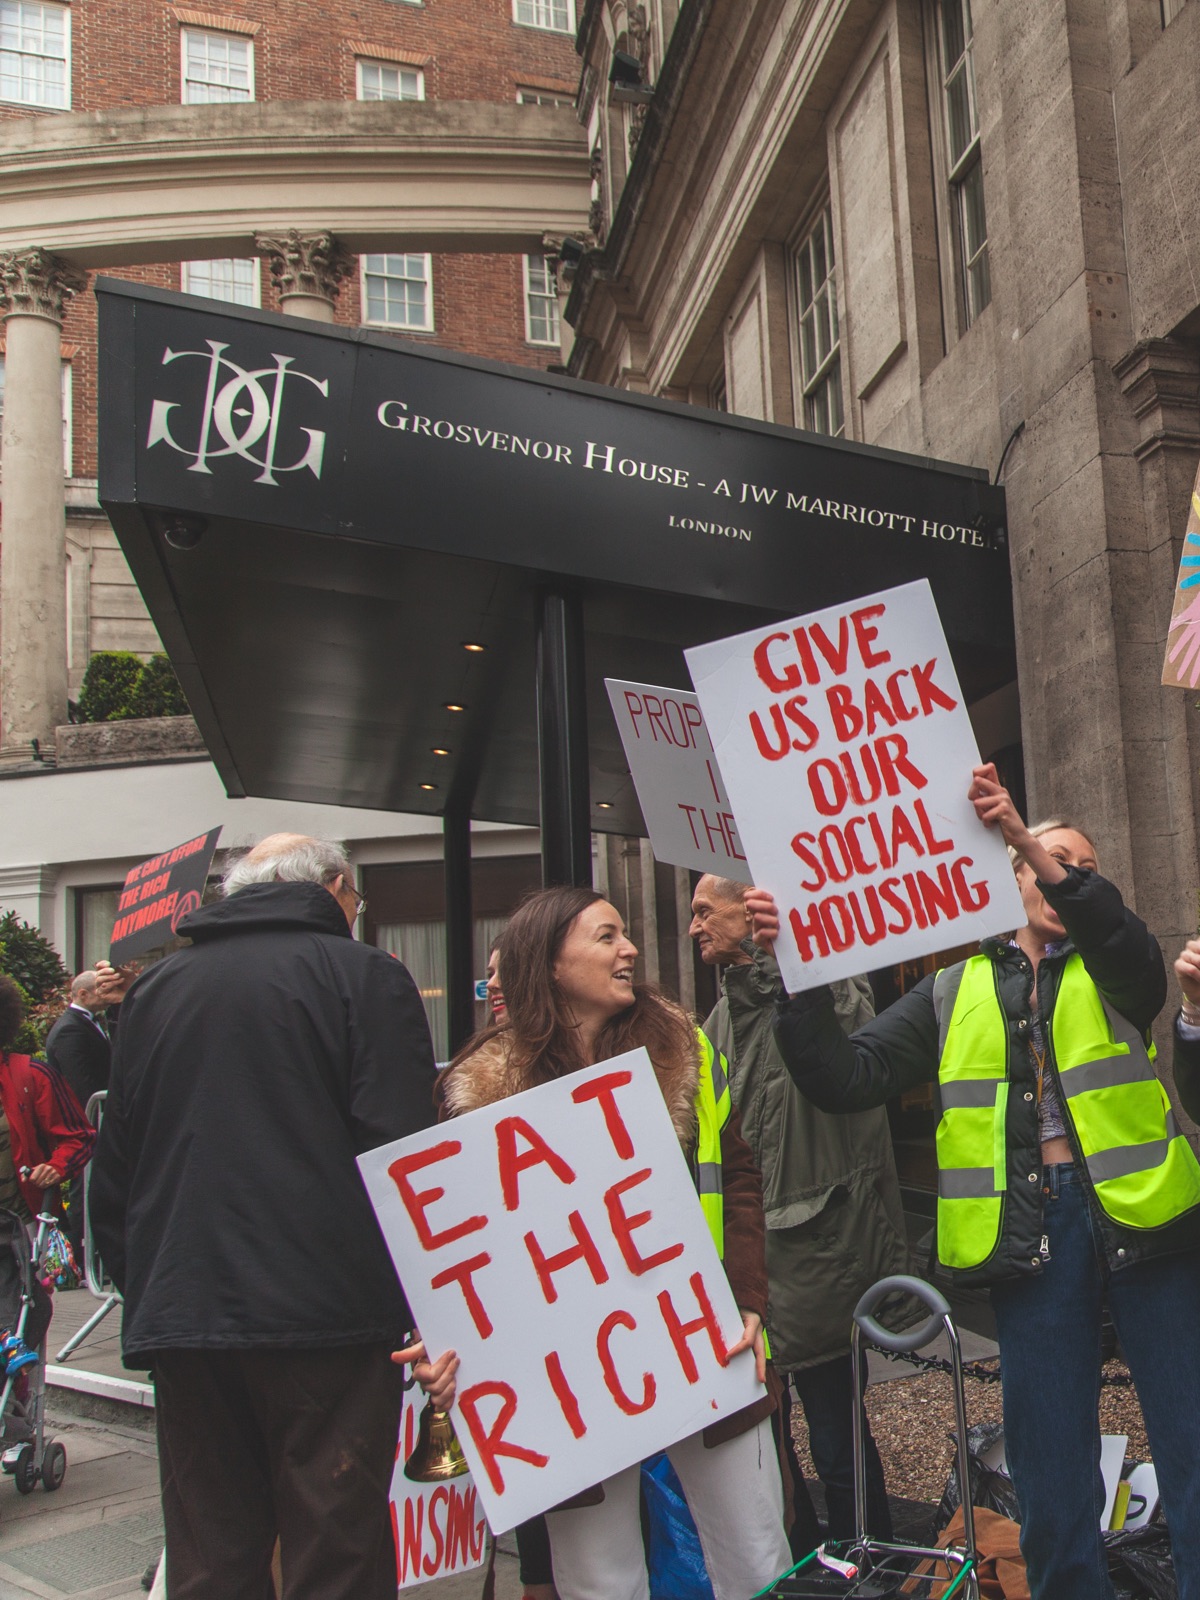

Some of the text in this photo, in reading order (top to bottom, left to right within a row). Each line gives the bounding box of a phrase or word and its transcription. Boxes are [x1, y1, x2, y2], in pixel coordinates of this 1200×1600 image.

[668, 515, 753, 542] LONDON
[713, 479, 732, 497] A
[739, 483, 778, 505] JW
[785, 492, 916, 533] MARRIOTT
[921, 519, 998, 550] HOTE
[753, 603, 891, 694] GIVE
[624, 691, 715, 752] PROP
[749, 657, 958, 761] US BACK
[806, 733, 928, 817] OUR
[125, 834, 208, 887] WE CAN'T AFFORD
[677, 803, 747, 861] THE
[790, 798, 954, 892] SOCIAL
[110, 891, 179, 944] ANYMORE!
[119, 871, 171, 912] THE RICH
[788, 856, 991, 963] HOUSING
[388, 1070, 633, 1252] EAT
[431, 1167, 685, 1340] THE
[457, 1271, 731, 1496] RICH
[389, 1484, 486, 1586] NSING
